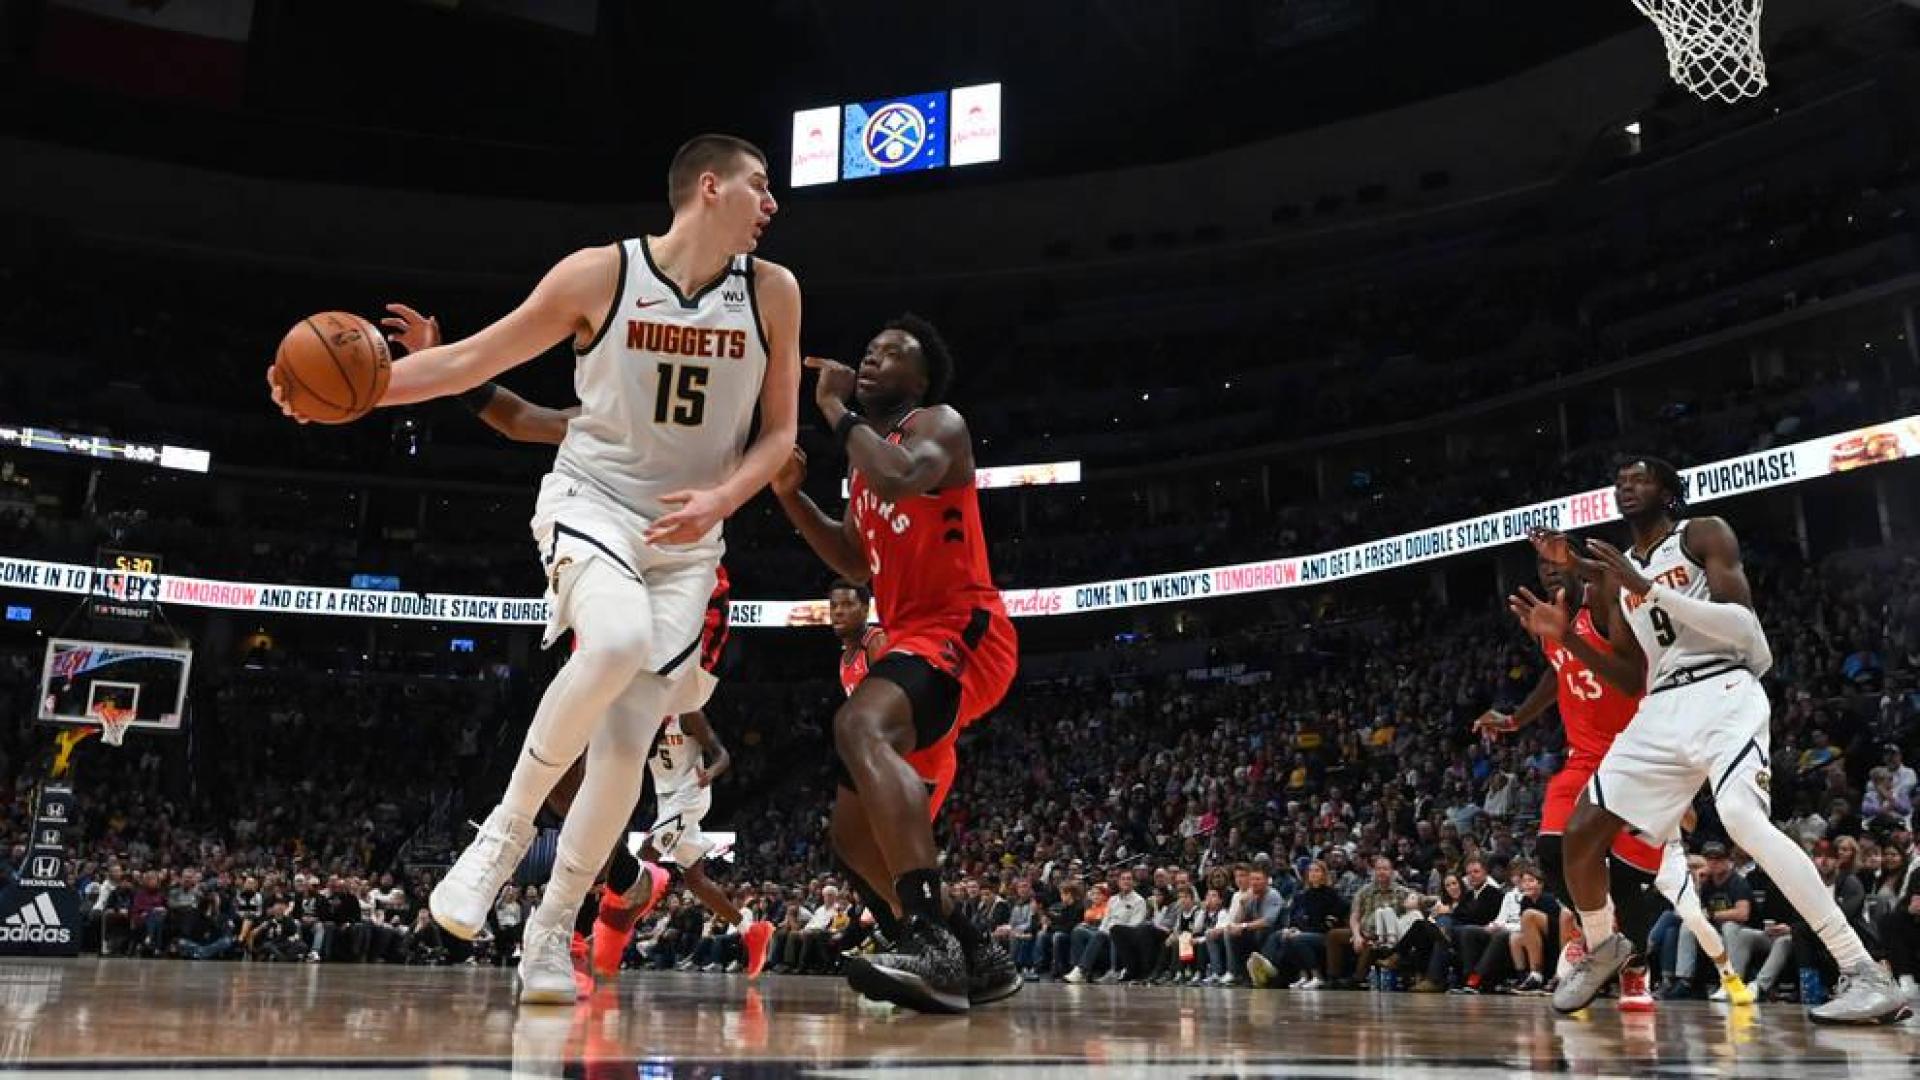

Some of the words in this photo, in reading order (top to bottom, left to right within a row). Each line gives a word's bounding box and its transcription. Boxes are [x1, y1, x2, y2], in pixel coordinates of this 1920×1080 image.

[721, 290, 745, 302] WU
[626, 319, 746, 359] NUGGETS
[653, 362, 709, 427] 15
[1006, 588, 1062, 615] endy's
[1076, 586, 1111, 609] COME
[1115, 583, 1128, 604] IN
[1131, 580, 1147, 602] TO
[1151, 573, 1211, 600] WENDY'S
[1215, 563, 1296, 592] TOMORROW
[1300, 558, 1327, 581] AND
[1329, 552, 1351, 576] GET
[1354, 550, 1363, 570] A
[1364, 540, 1402, 569] FRESH
[1405, 532, 1454, 560] DOUBLE
[1457, 519, 1501, 548] STACK
[1570, 492, 1610, 527] FREE
[1696, 450, 1796, 497] PURCHASE!
[116, 555, 153, 575] 5:30
[44, 567, 62, 587] IN
[67, 569, 86, 590] TO
[166, 580, 257, 605] TOMORROW
[259, 588, 291, 609] AND
[294, 590, 322, 611] GET
[326, 592, 336, 610] A
[340, 592, 387, 614] FRESH
[391, 596, 446, 617] DOUBLE
[451, 600, 499, 619] STACK
[501, 602, 553, 621] BURGE
[1649, 606, 1676, 647] 9
[1566, 669, 1603, 701] 43
[0, 922, 71, 944] adidas
